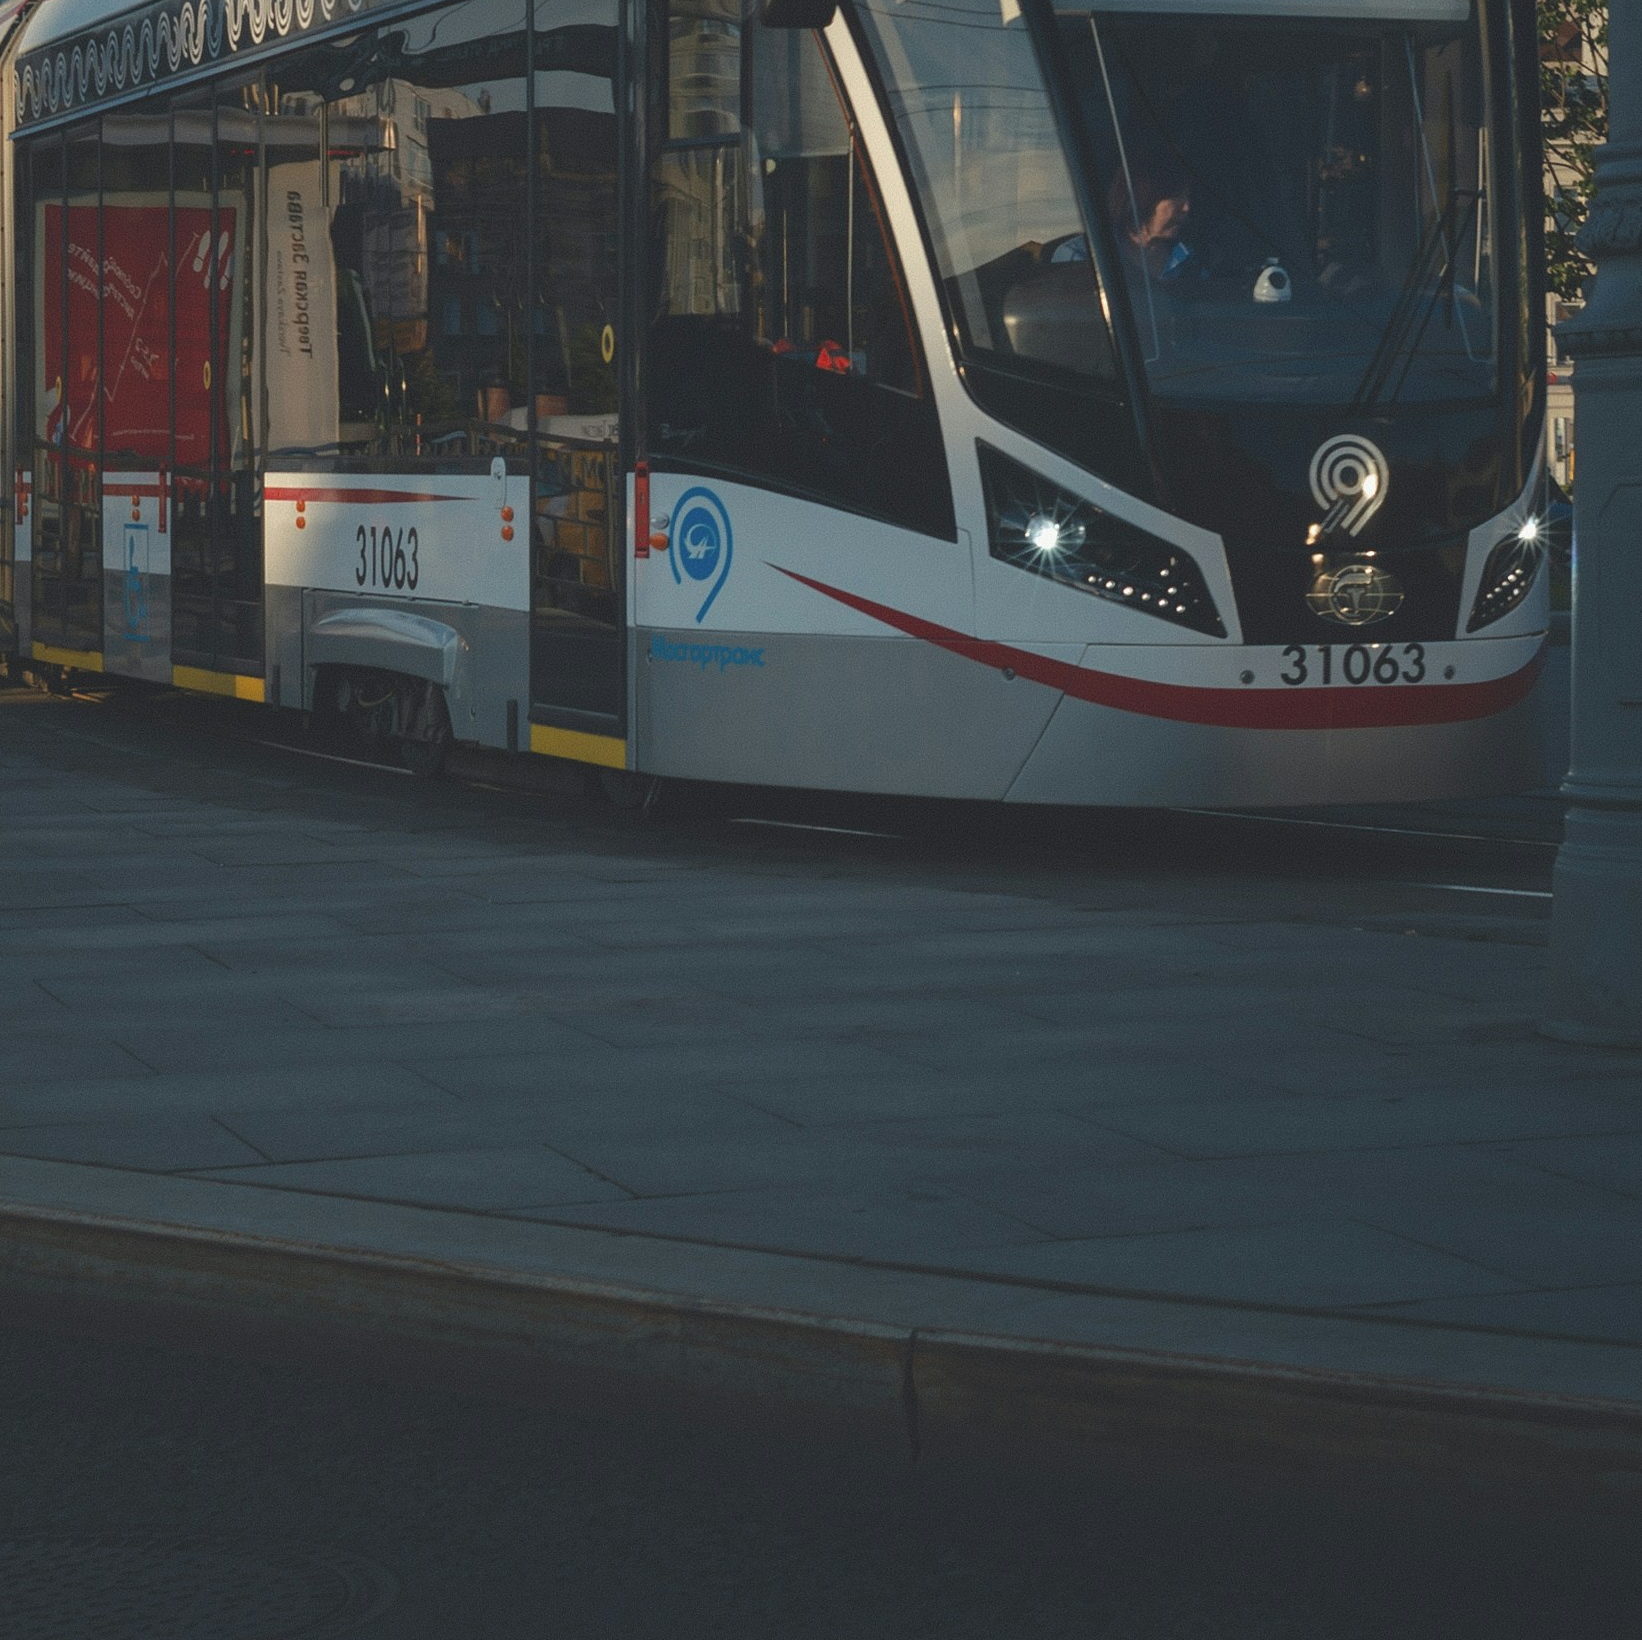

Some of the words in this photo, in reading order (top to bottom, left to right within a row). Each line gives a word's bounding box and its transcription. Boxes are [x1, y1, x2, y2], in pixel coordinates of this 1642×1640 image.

[355, 524, 419, 591] 31063
[651, 634, 766, 673] Мосгортранс
[1280, 643, 1426, 686] 31063
